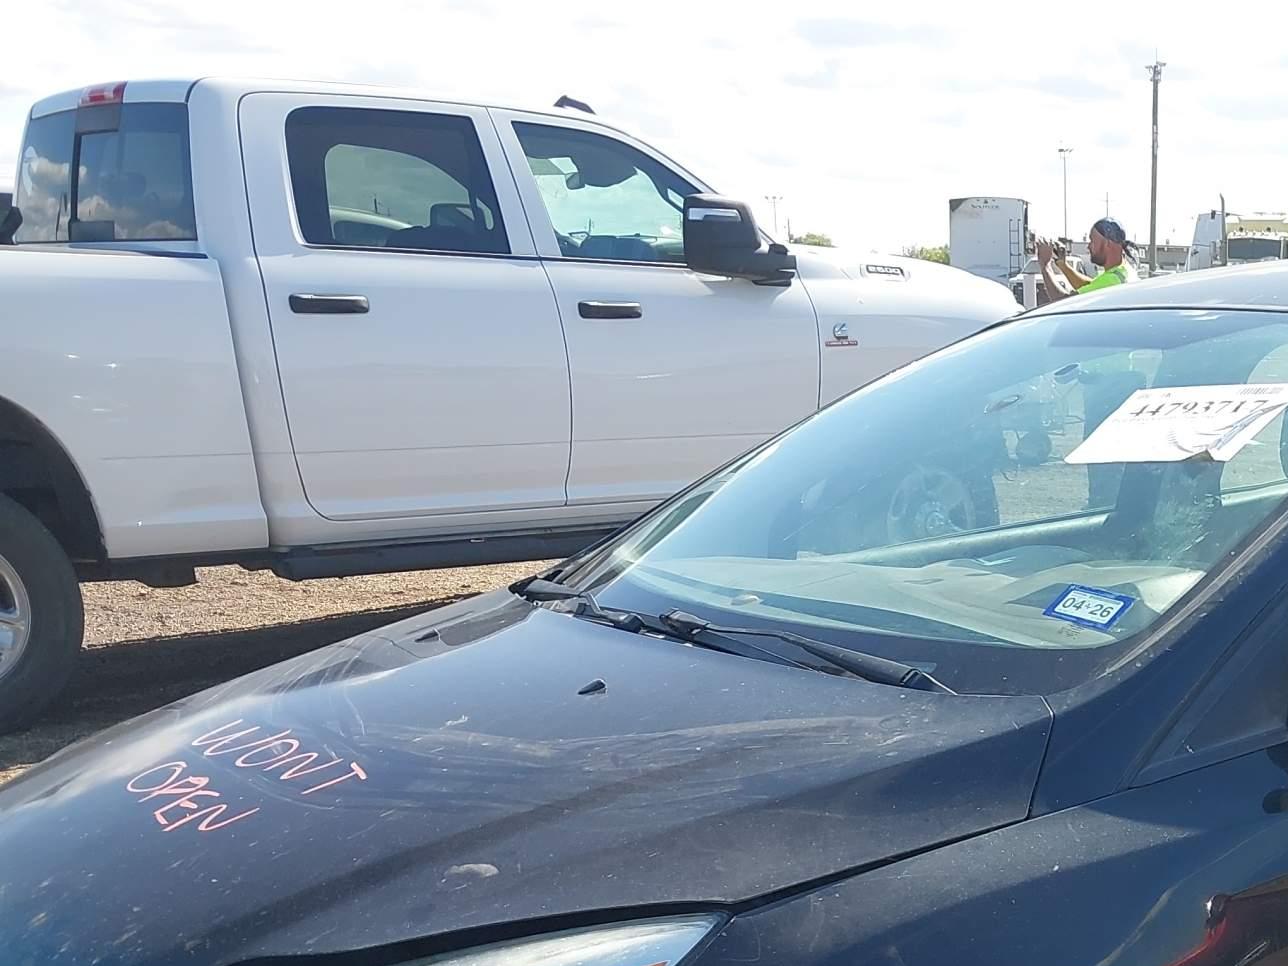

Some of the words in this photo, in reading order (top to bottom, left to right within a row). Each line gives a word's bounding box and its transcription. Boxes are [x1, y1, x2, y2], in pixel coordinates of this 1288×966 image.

[1130, 399, 1270, 417] 44793717
[191, 719, 368, 796] WONT
[126, 761, 261, 832] OPEN
